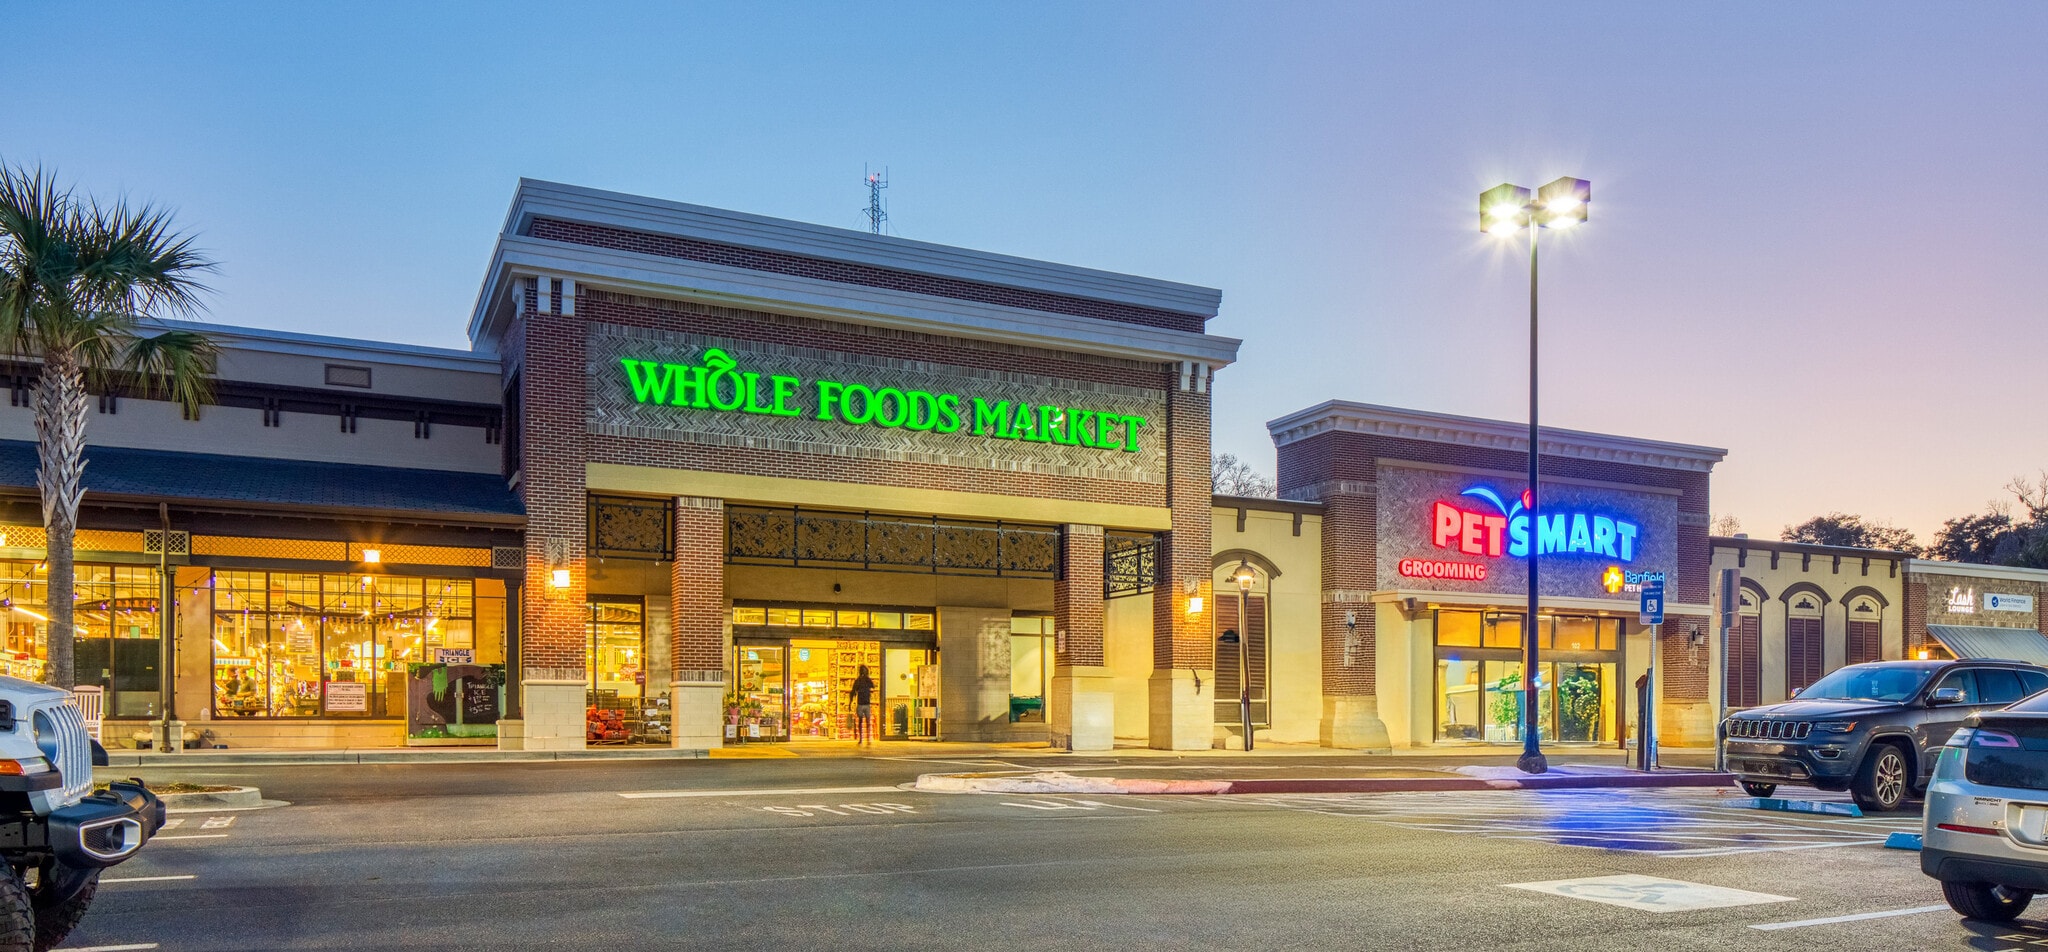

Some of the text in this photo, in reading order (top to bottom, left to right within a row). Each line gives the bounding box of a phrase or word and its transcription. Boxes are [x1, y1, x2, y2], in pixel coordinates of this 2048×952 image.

[621, 349, 1145, 451] WHOLE FOODS MARKET
[1400, 558, 1486, 581] GROOMING
[1625, 570, 1665, 584] Banfield
[1625, 584, 1636, 592] PET
[1949, 587, 1974, 606] Lash
[1948, 605, 1974, 613] LOUNGE
[442, 649, 470, 657] TRIANGLE
[763, 802, 920, 817] STOP
